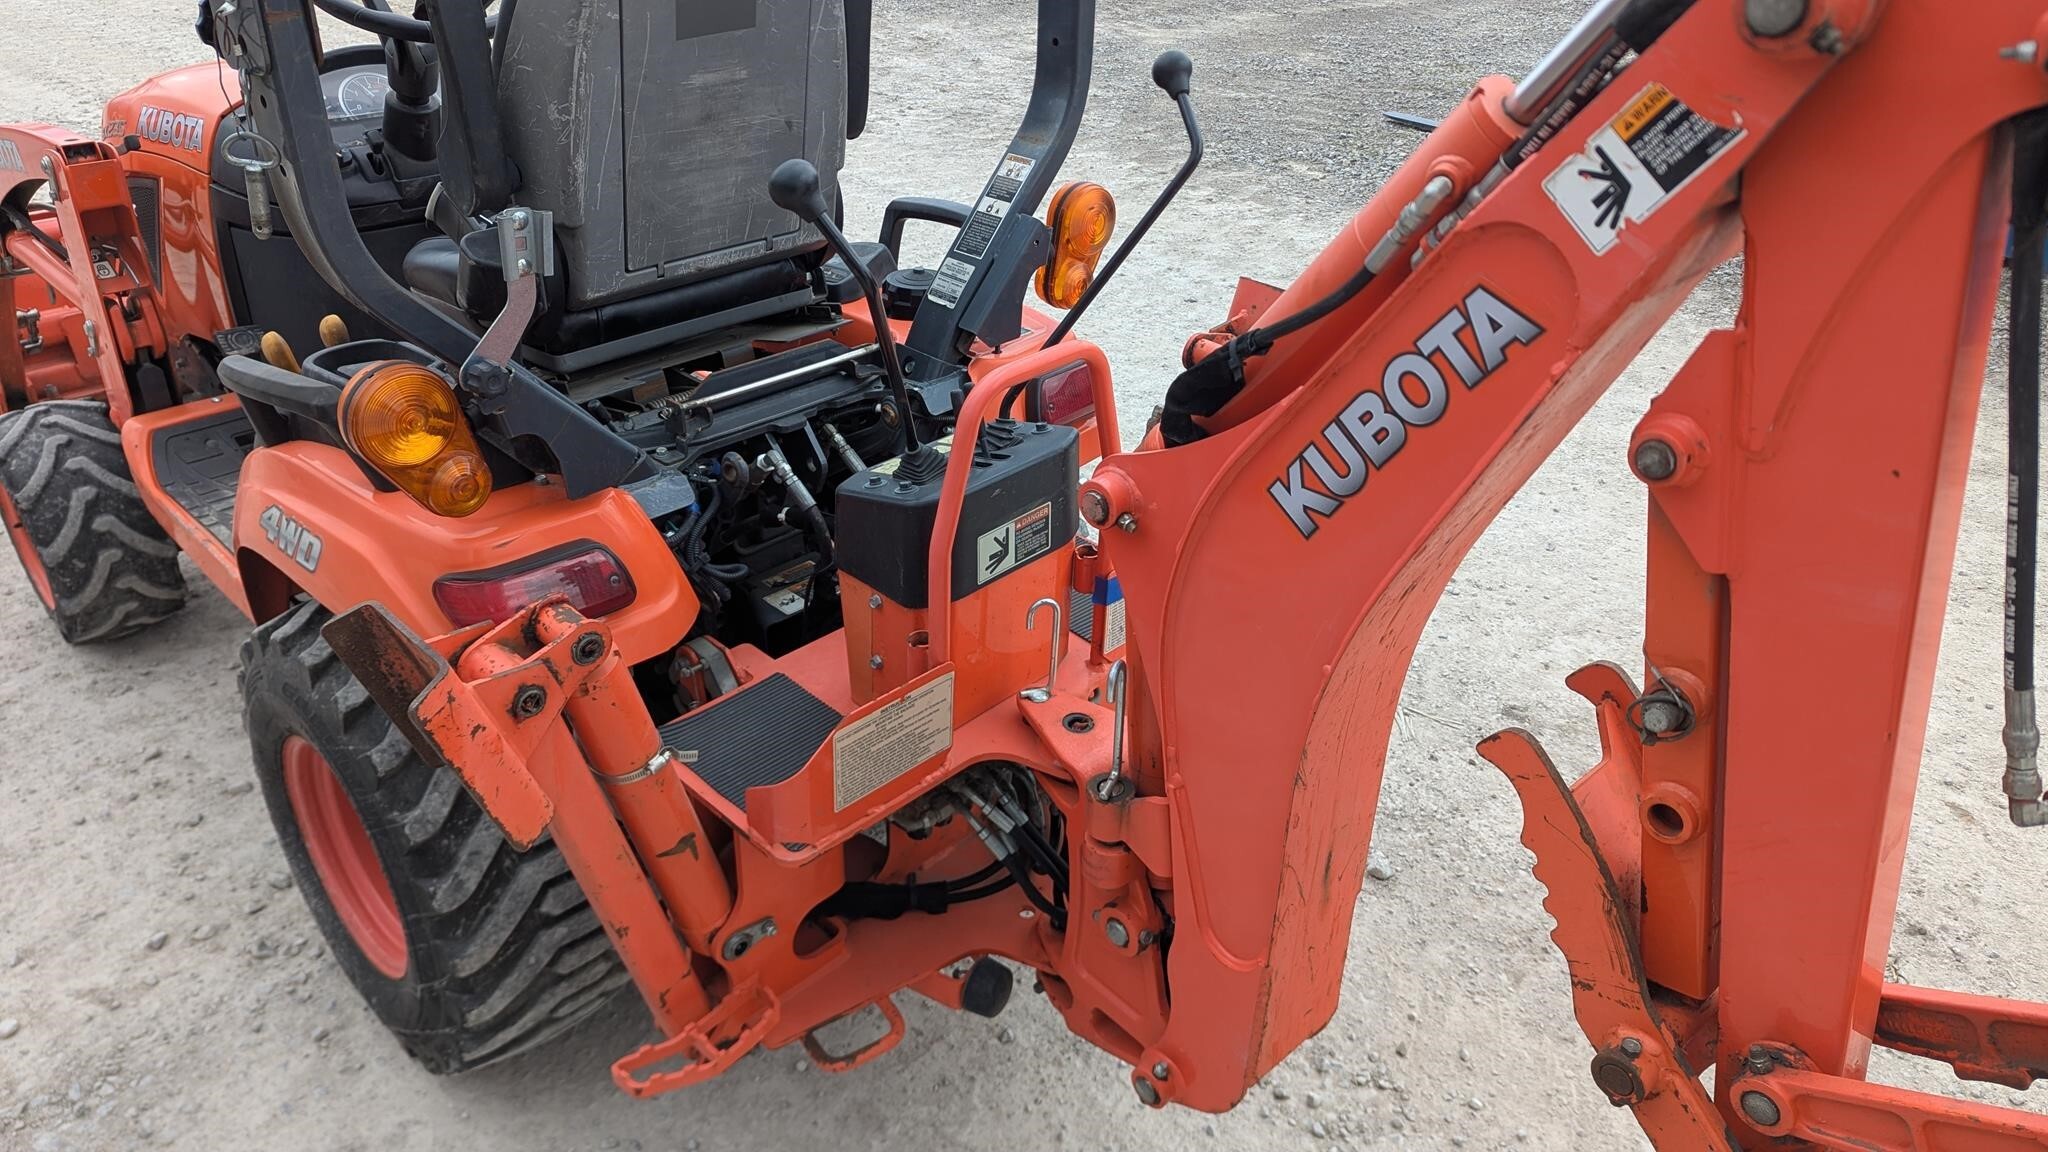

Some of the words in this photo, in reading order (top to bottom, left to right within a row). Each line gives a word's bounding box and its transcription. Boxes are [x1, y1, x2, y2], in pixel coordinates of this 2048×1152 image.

[1632, 87, 1668, 121] WARN
[136, 104, 204, 153] KUBOTA
[1267, 284, 1546, 541] KUBOTA
[1021, 507, 1049, 526] DANGER
[259, 503, 323, 574] 4WD
[2008, 523, 2018, 557] MADE
